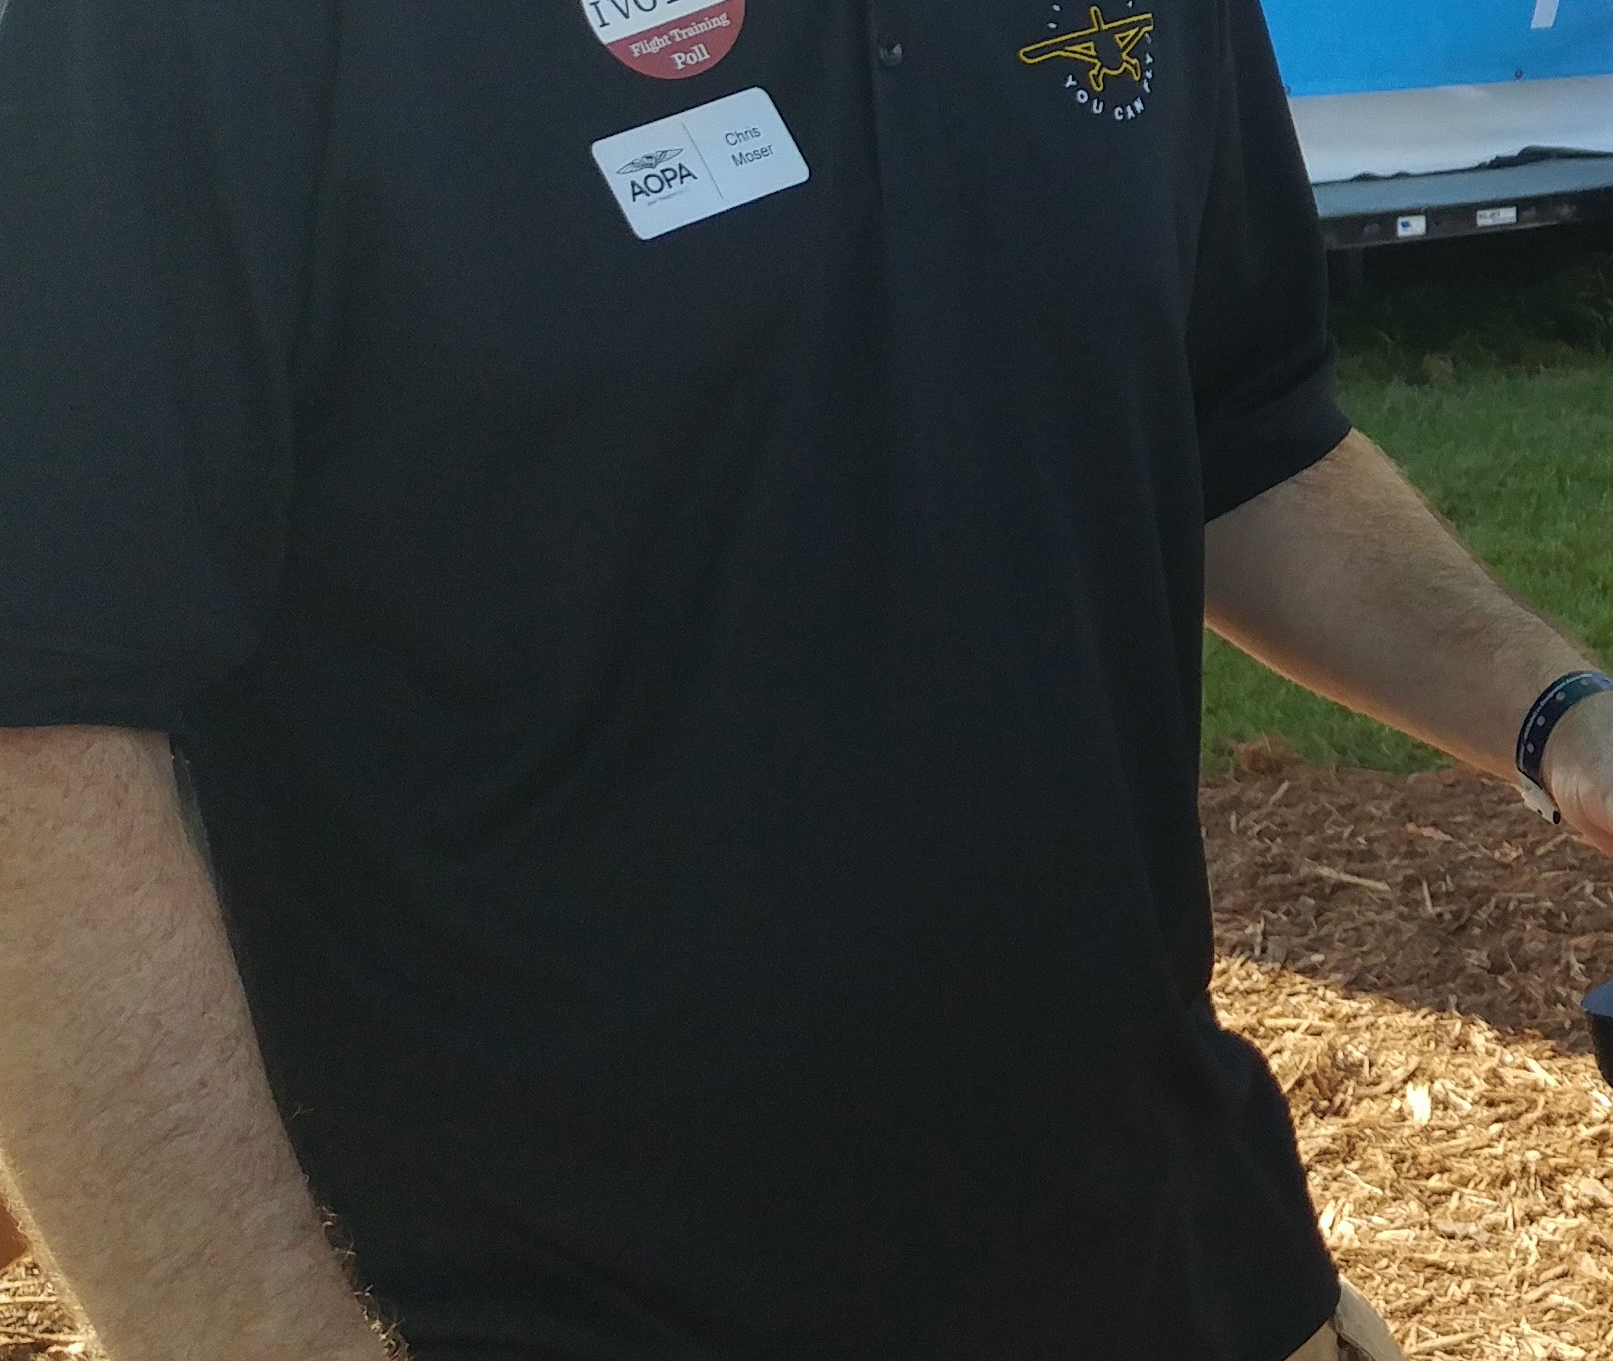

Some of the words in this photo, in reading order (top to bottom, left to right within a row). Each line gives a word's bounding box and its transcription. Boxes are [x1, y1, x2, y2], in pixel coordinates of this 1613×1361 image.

[589, 0, 610, 28] I
[628, 33, 672, 58] Flight
[669, 12, 731, 42] Training
[670, 43, 711, 70] Poll
[1064, 74, 1105, 115] YOU
[1114, 96, 1145, 120] CAN
[725, 125, 761, 147] Chris
[731, 143, 774, 168] Moser
[630, 162, 699, 203] AOPA
